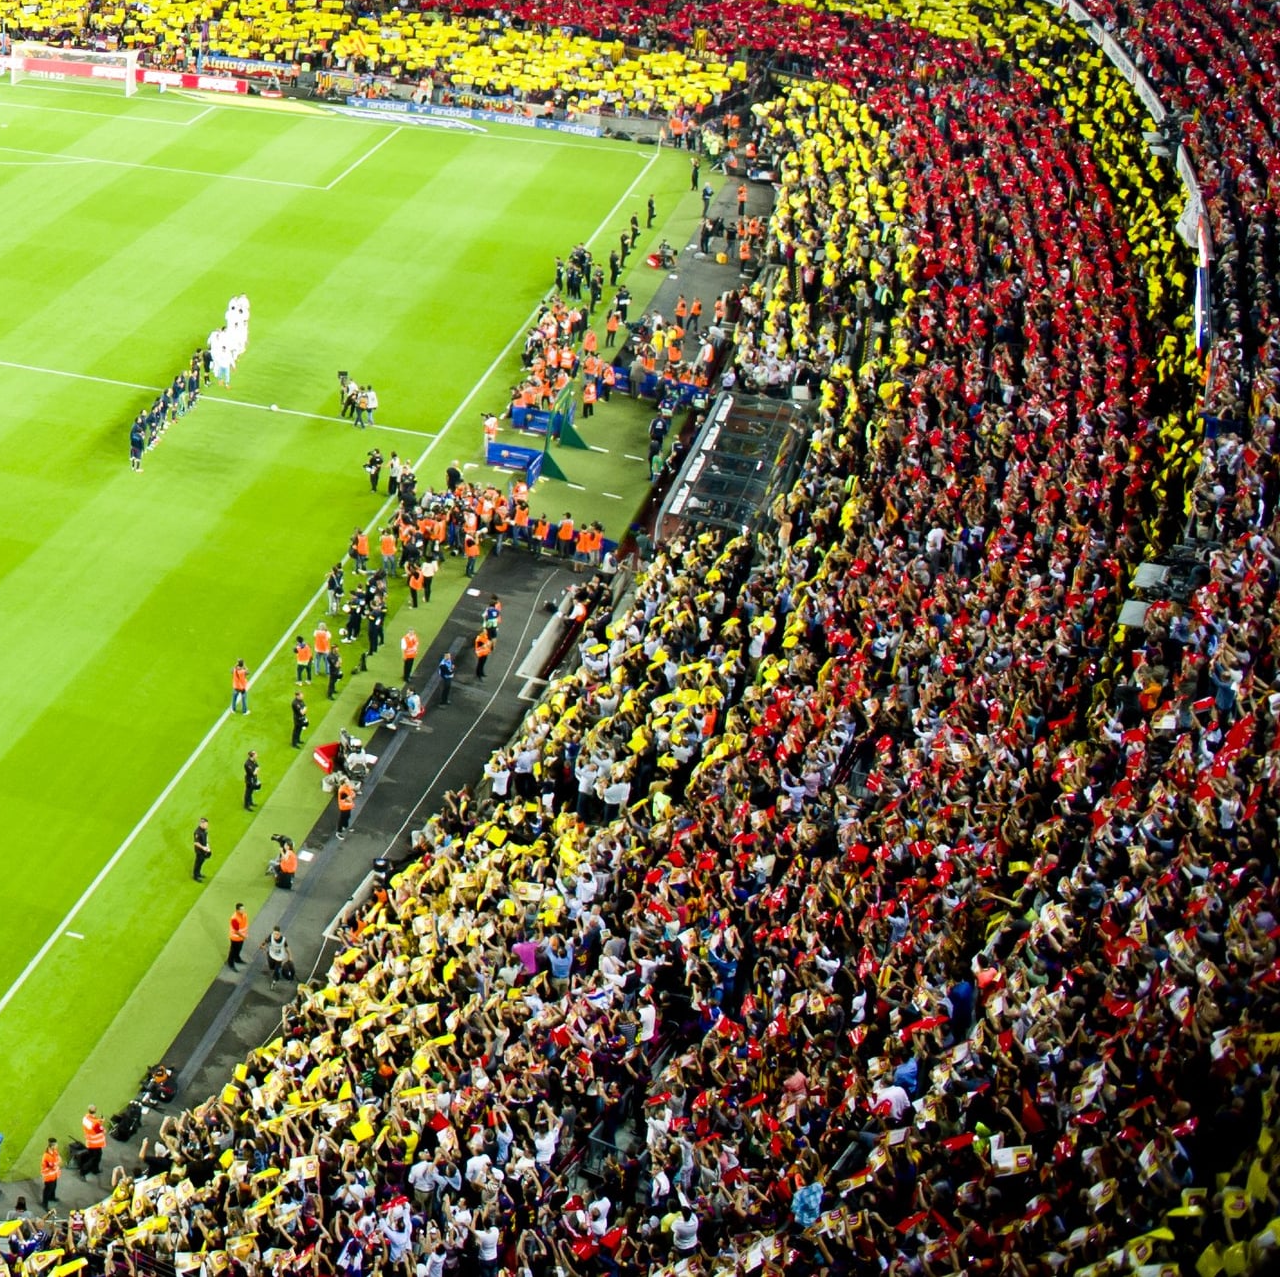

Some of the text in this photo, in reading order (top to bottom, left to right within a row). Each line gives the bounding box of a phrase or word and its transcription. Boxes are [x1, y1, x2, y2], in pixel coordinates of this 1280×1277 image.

[366, 100, 408, 112] randstad
[431, 107, 472, 119] randstad
[494, 114, 536, 126] randstad
[558, 123, 598, 136] randstad
